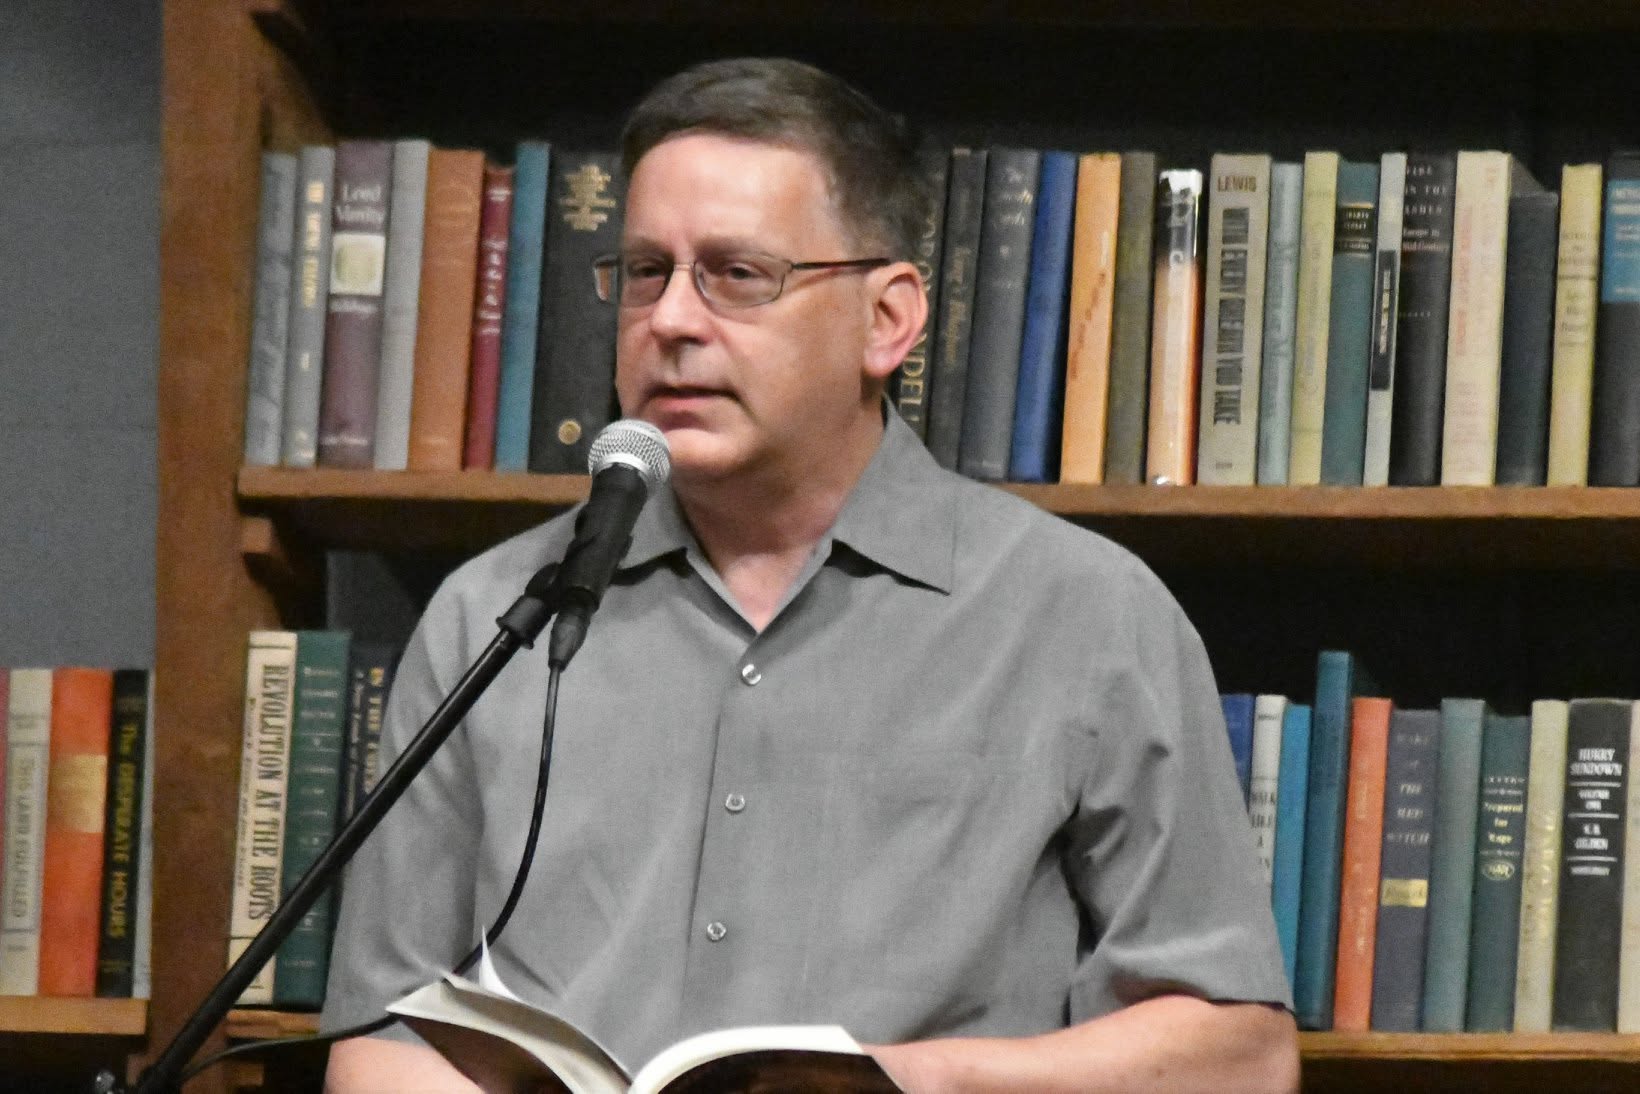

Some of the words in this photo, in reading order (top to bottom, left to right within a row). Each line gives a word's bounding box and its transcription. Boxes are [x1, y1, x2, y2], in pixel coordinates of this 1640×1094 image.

[1217, 176, 1256, 192] LEWIS
[257, 664, 291, 780] REVOLUTION
[1578, 747, 1616, 761] HURRY
[1569, 762, 1623, 777] SUNDOWN
[253, 788, 282, 811] AT
[252, 818, 281, 858] THE
[248, 865, 277, 922] ROOTS
